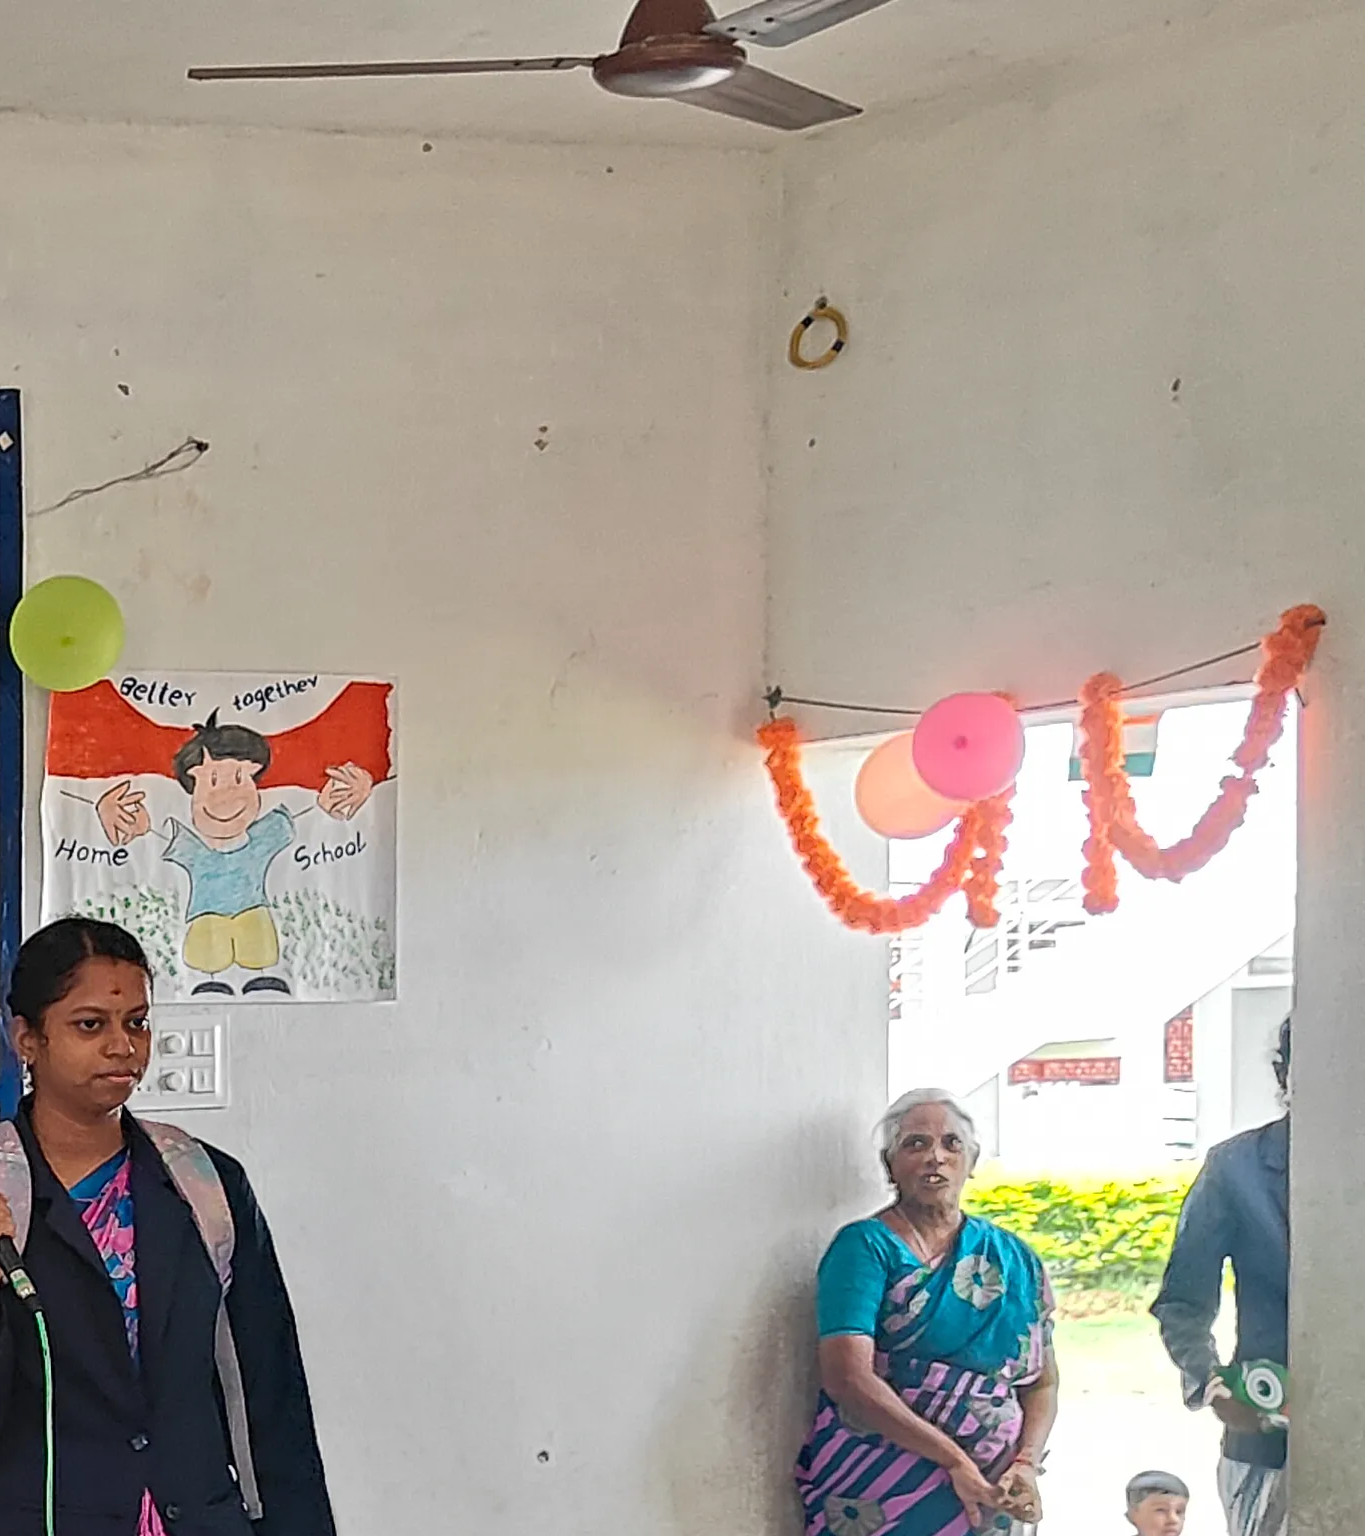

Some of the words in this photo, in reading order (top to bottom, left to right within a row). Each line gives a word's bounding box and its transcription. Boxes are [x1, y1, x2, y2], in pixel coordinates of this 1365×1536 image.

[232, 675, 319, 713] together
[54, 838, 130, 867] Home
[294, 831, 367, 871] School
